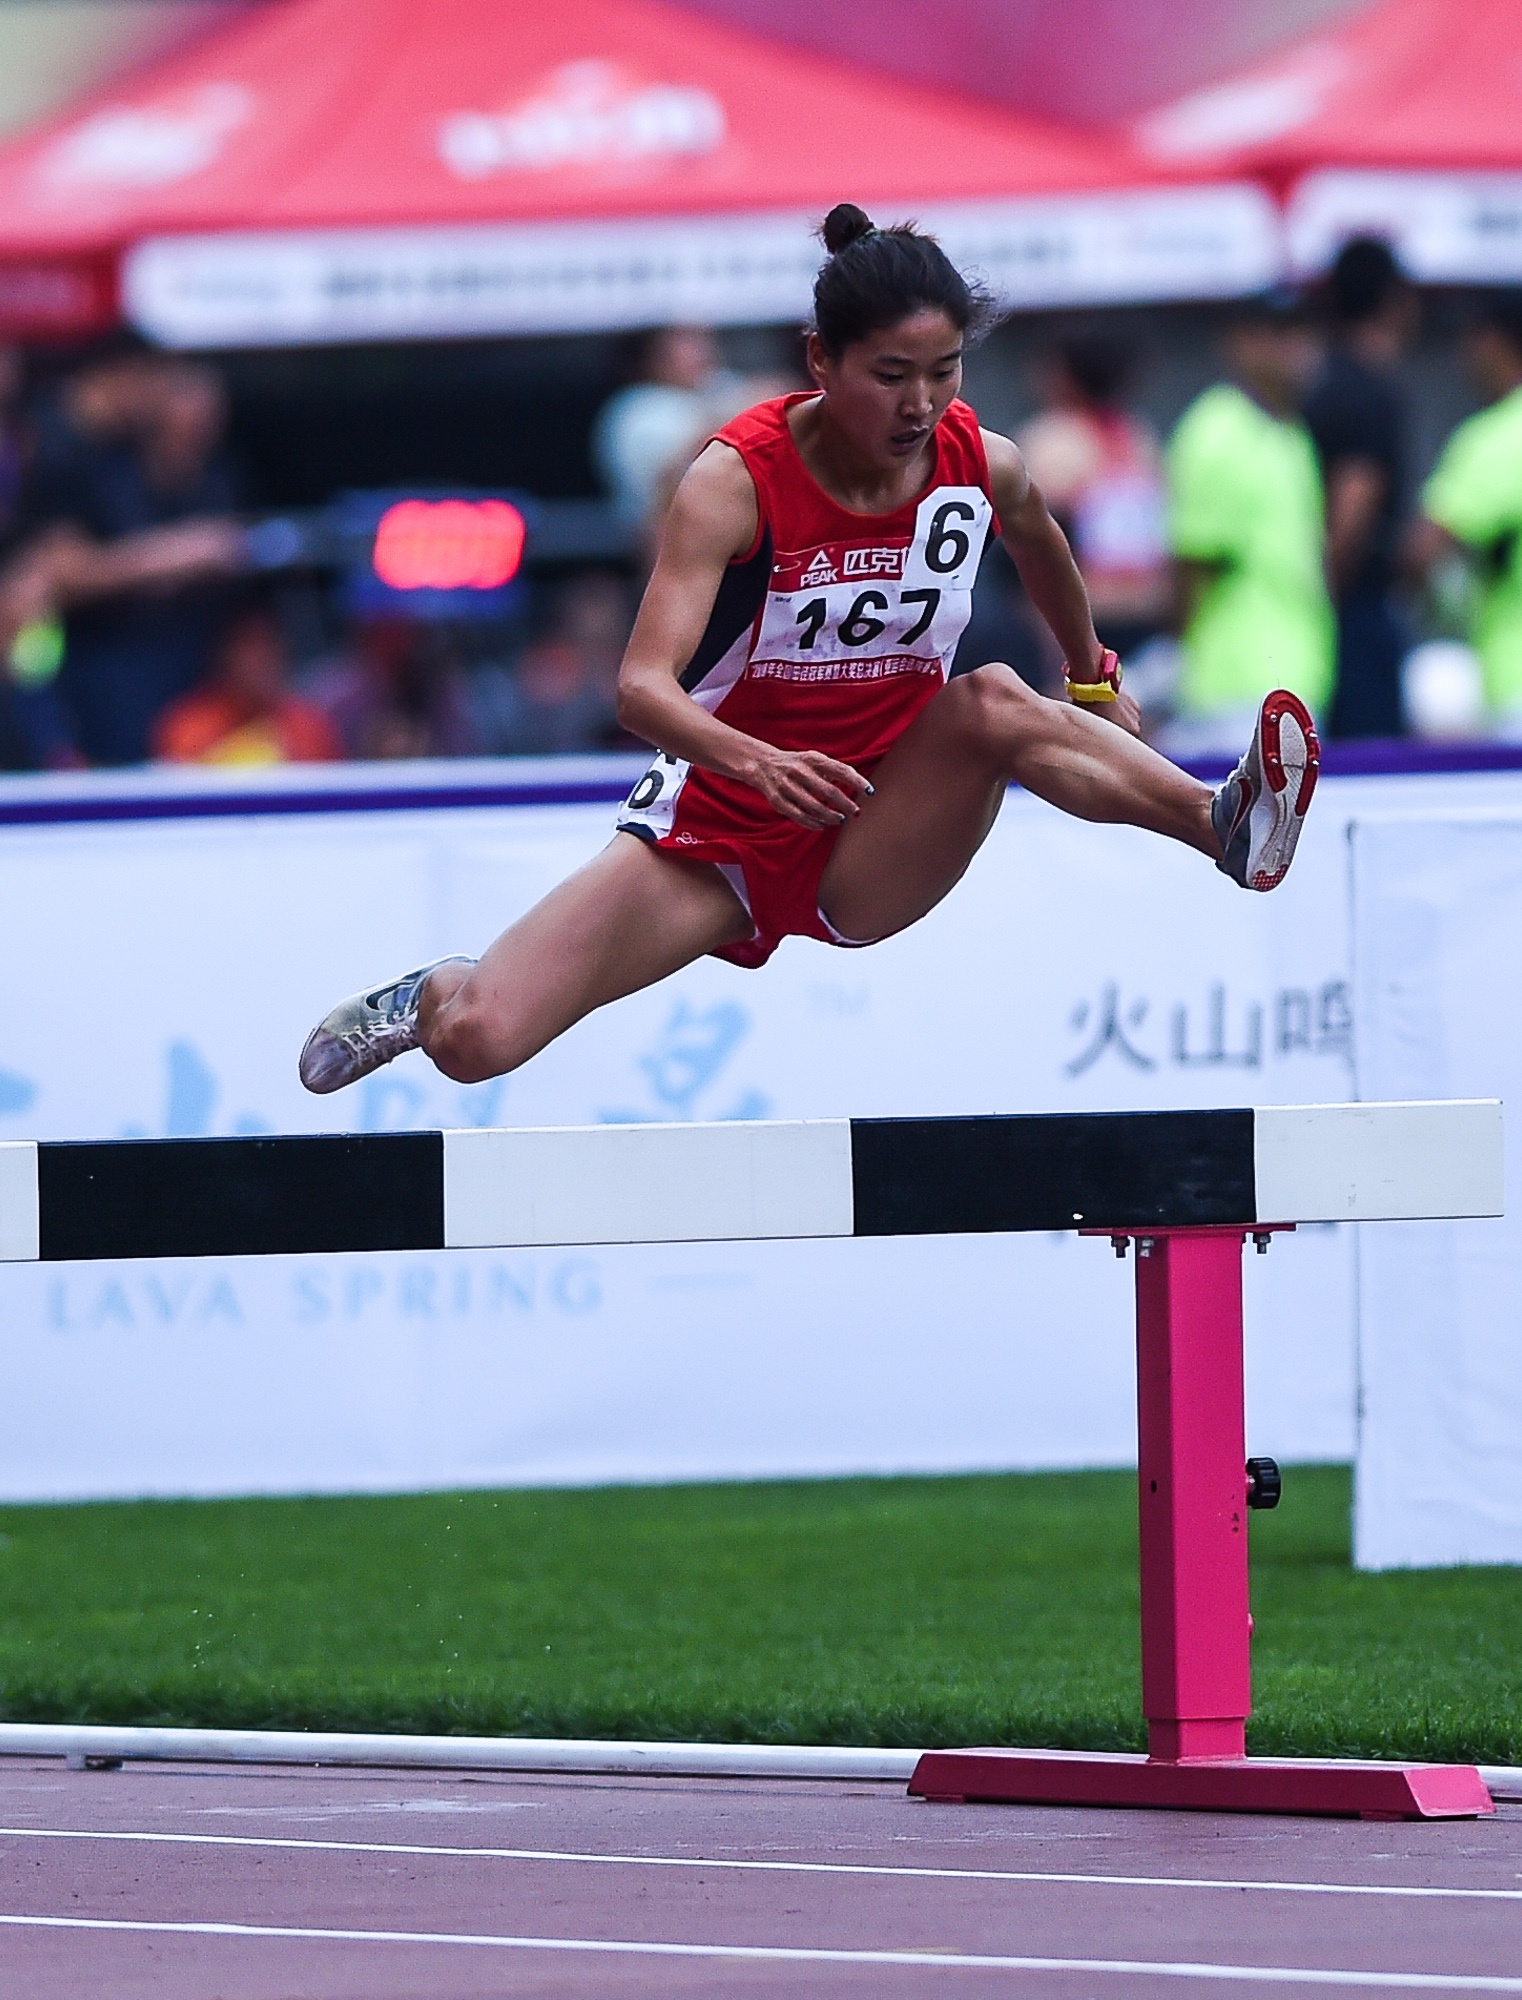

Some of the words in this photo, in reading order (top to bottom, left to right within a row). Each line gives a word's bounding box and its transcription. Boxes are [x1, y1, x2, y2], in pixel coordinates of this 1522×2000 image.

[843, 546, 910, 575] 匹克
[924, 501, 976, 574] 6
[800, 567, 840, 587] PEAK
[796, 588, 942, 650] 167
[47, 1272, 246, 1333] LAVA
[290, 1255, 603, 1325] SPRING
